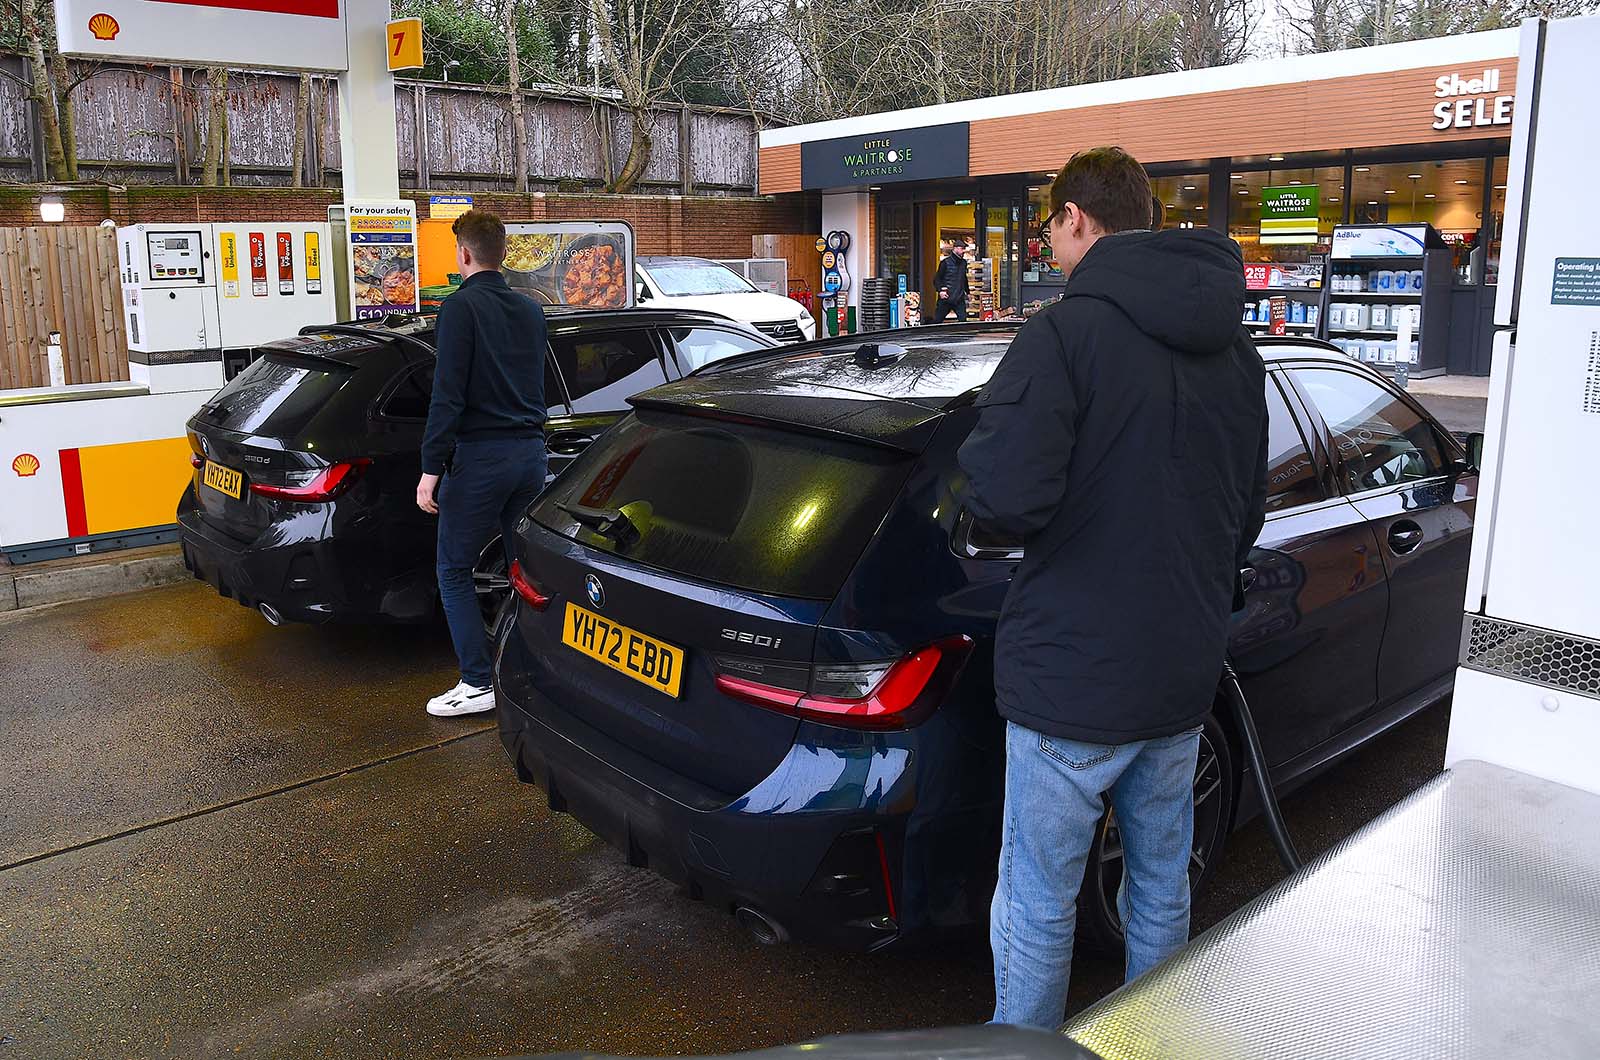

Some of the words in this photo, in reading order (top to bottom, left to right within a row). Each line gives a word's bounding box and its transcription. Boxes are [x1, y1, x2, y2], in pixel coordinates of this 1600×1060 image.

[393, 32, 405, 56] 7
[1434, 69, 1499, 97] Shell
[864, 139, 890, 149] LITTLE
[861, 166, 903, 176] PARTNERS
[1267, 199, 1310, 207] WAITROSE
[350, 206, 363, 214] For
[387, 207, 411, 215] safety
[1335, 231, 1361, 239] AdBlue
[536, 249, 591, 258] WAITROSE
[1557, 263, 1594, 272] Operating
[1245, 267, 1254, 279] 2
[207, 463, 224, 488] YH72
[224, 471, 240, 495] EAX
[721, 628, 782, 648] 320i
[572, 608, 623, 664] YH72
[626, 634, 673, 686] EBD
